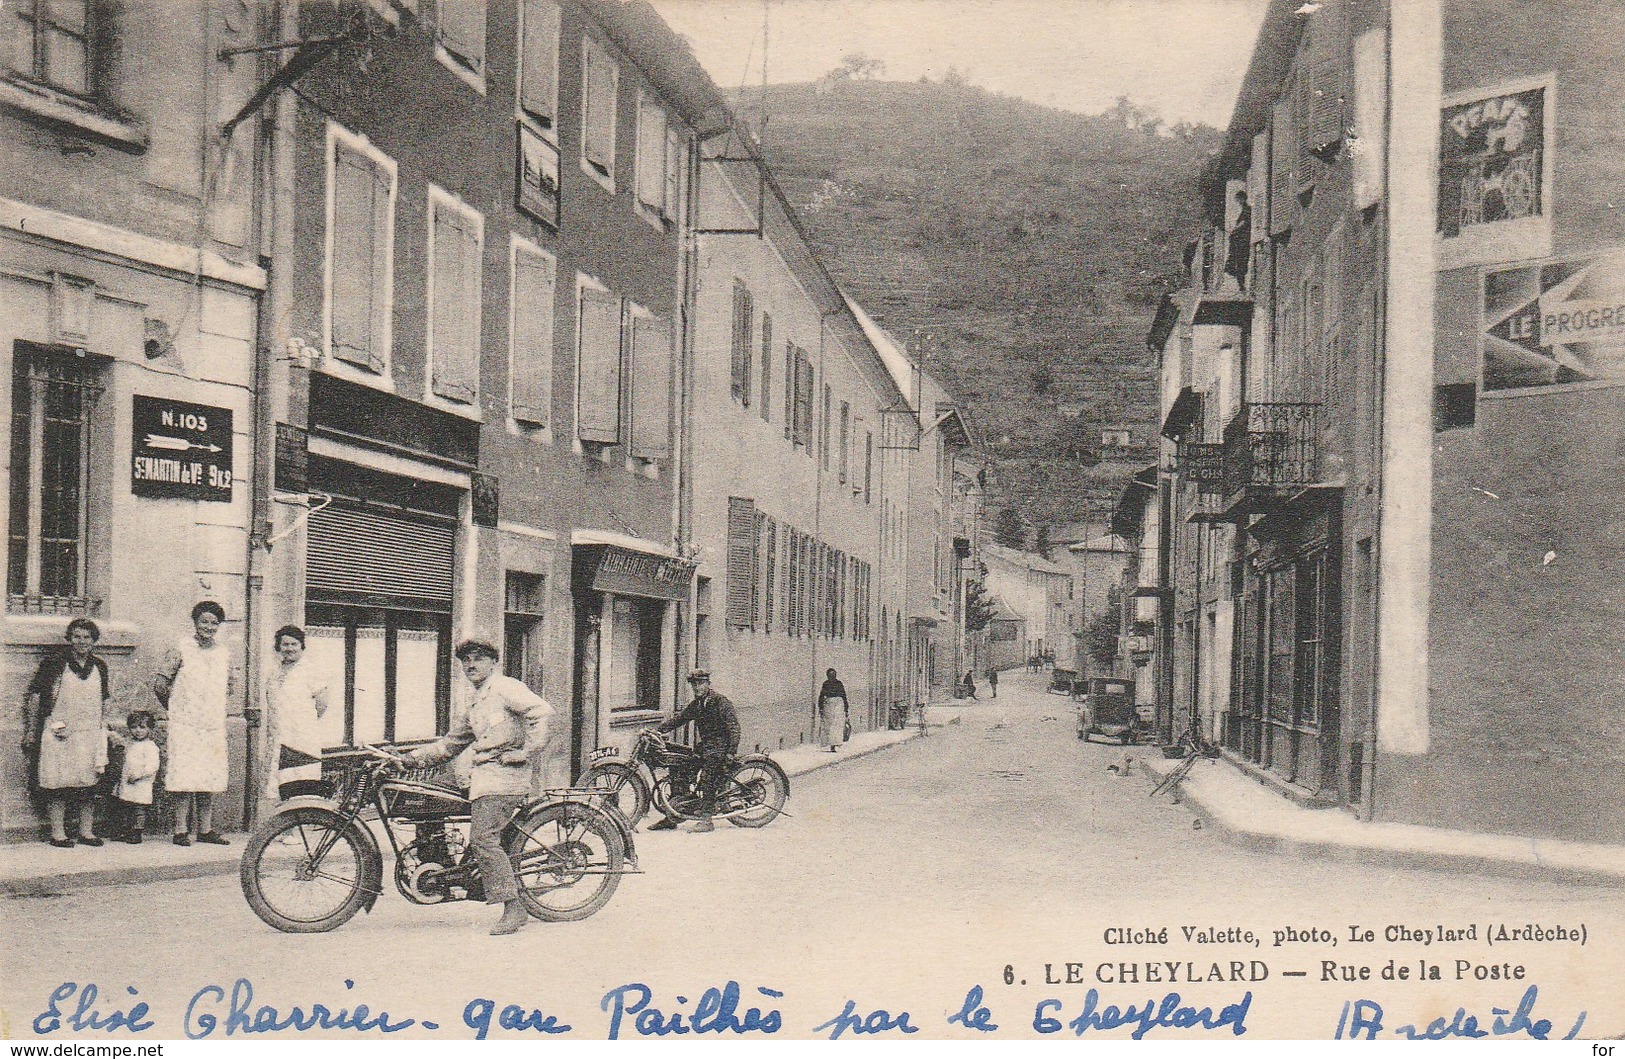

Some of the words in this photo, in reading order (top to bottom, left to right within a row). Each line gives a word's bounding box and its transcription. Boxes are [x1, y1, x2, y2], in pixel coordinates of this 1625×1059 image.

[1508, 314, 1533, 340] LE
[145, 457, 181, 483] MARTIN
[813, 1000, 919, 1040] par
[947, 985, 998, 1032] le
[1033, 988, 1253, 1040] Cheylard
